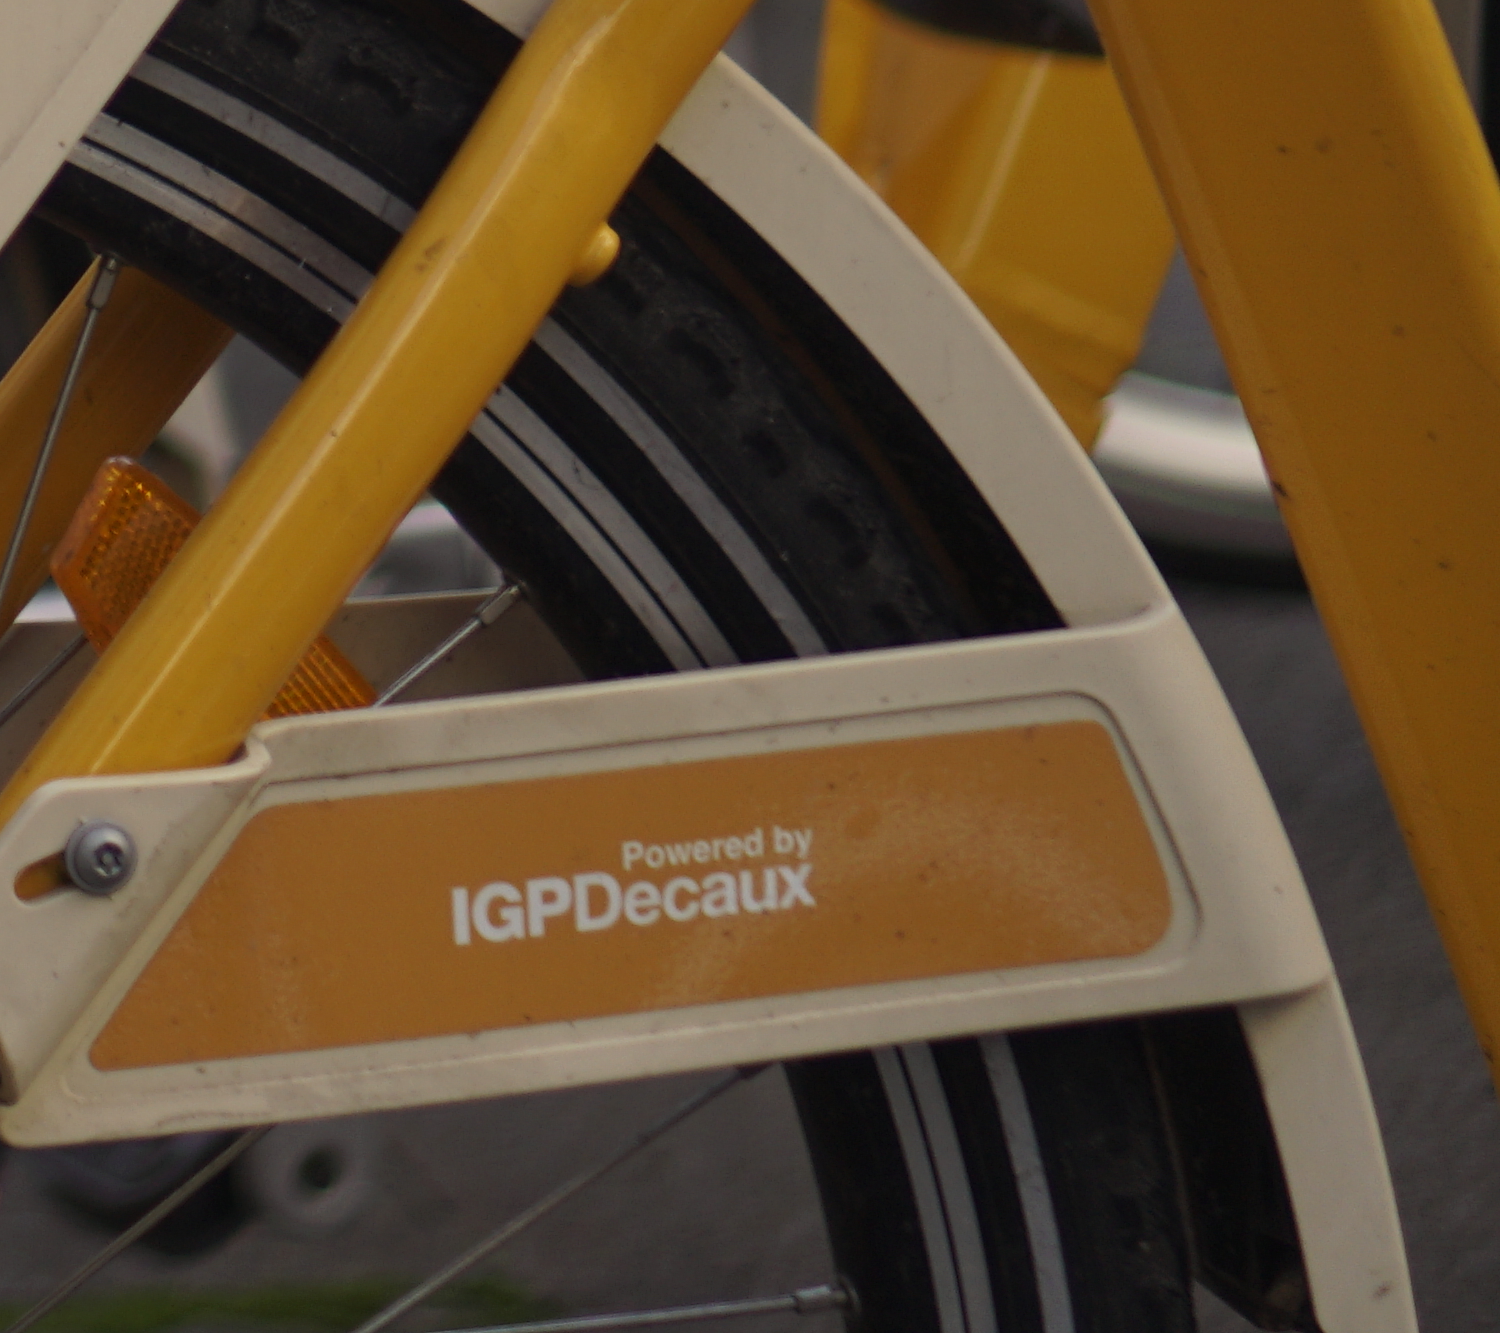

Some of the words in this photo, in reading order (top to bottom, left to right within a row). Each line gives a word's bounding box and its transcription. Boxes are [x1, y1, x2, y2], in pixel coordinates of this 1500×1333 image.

[621, 827, 765, 872] Powered
[772, 824, 814, 860] by
[450, 862, 817, 947] IGPDecaux
